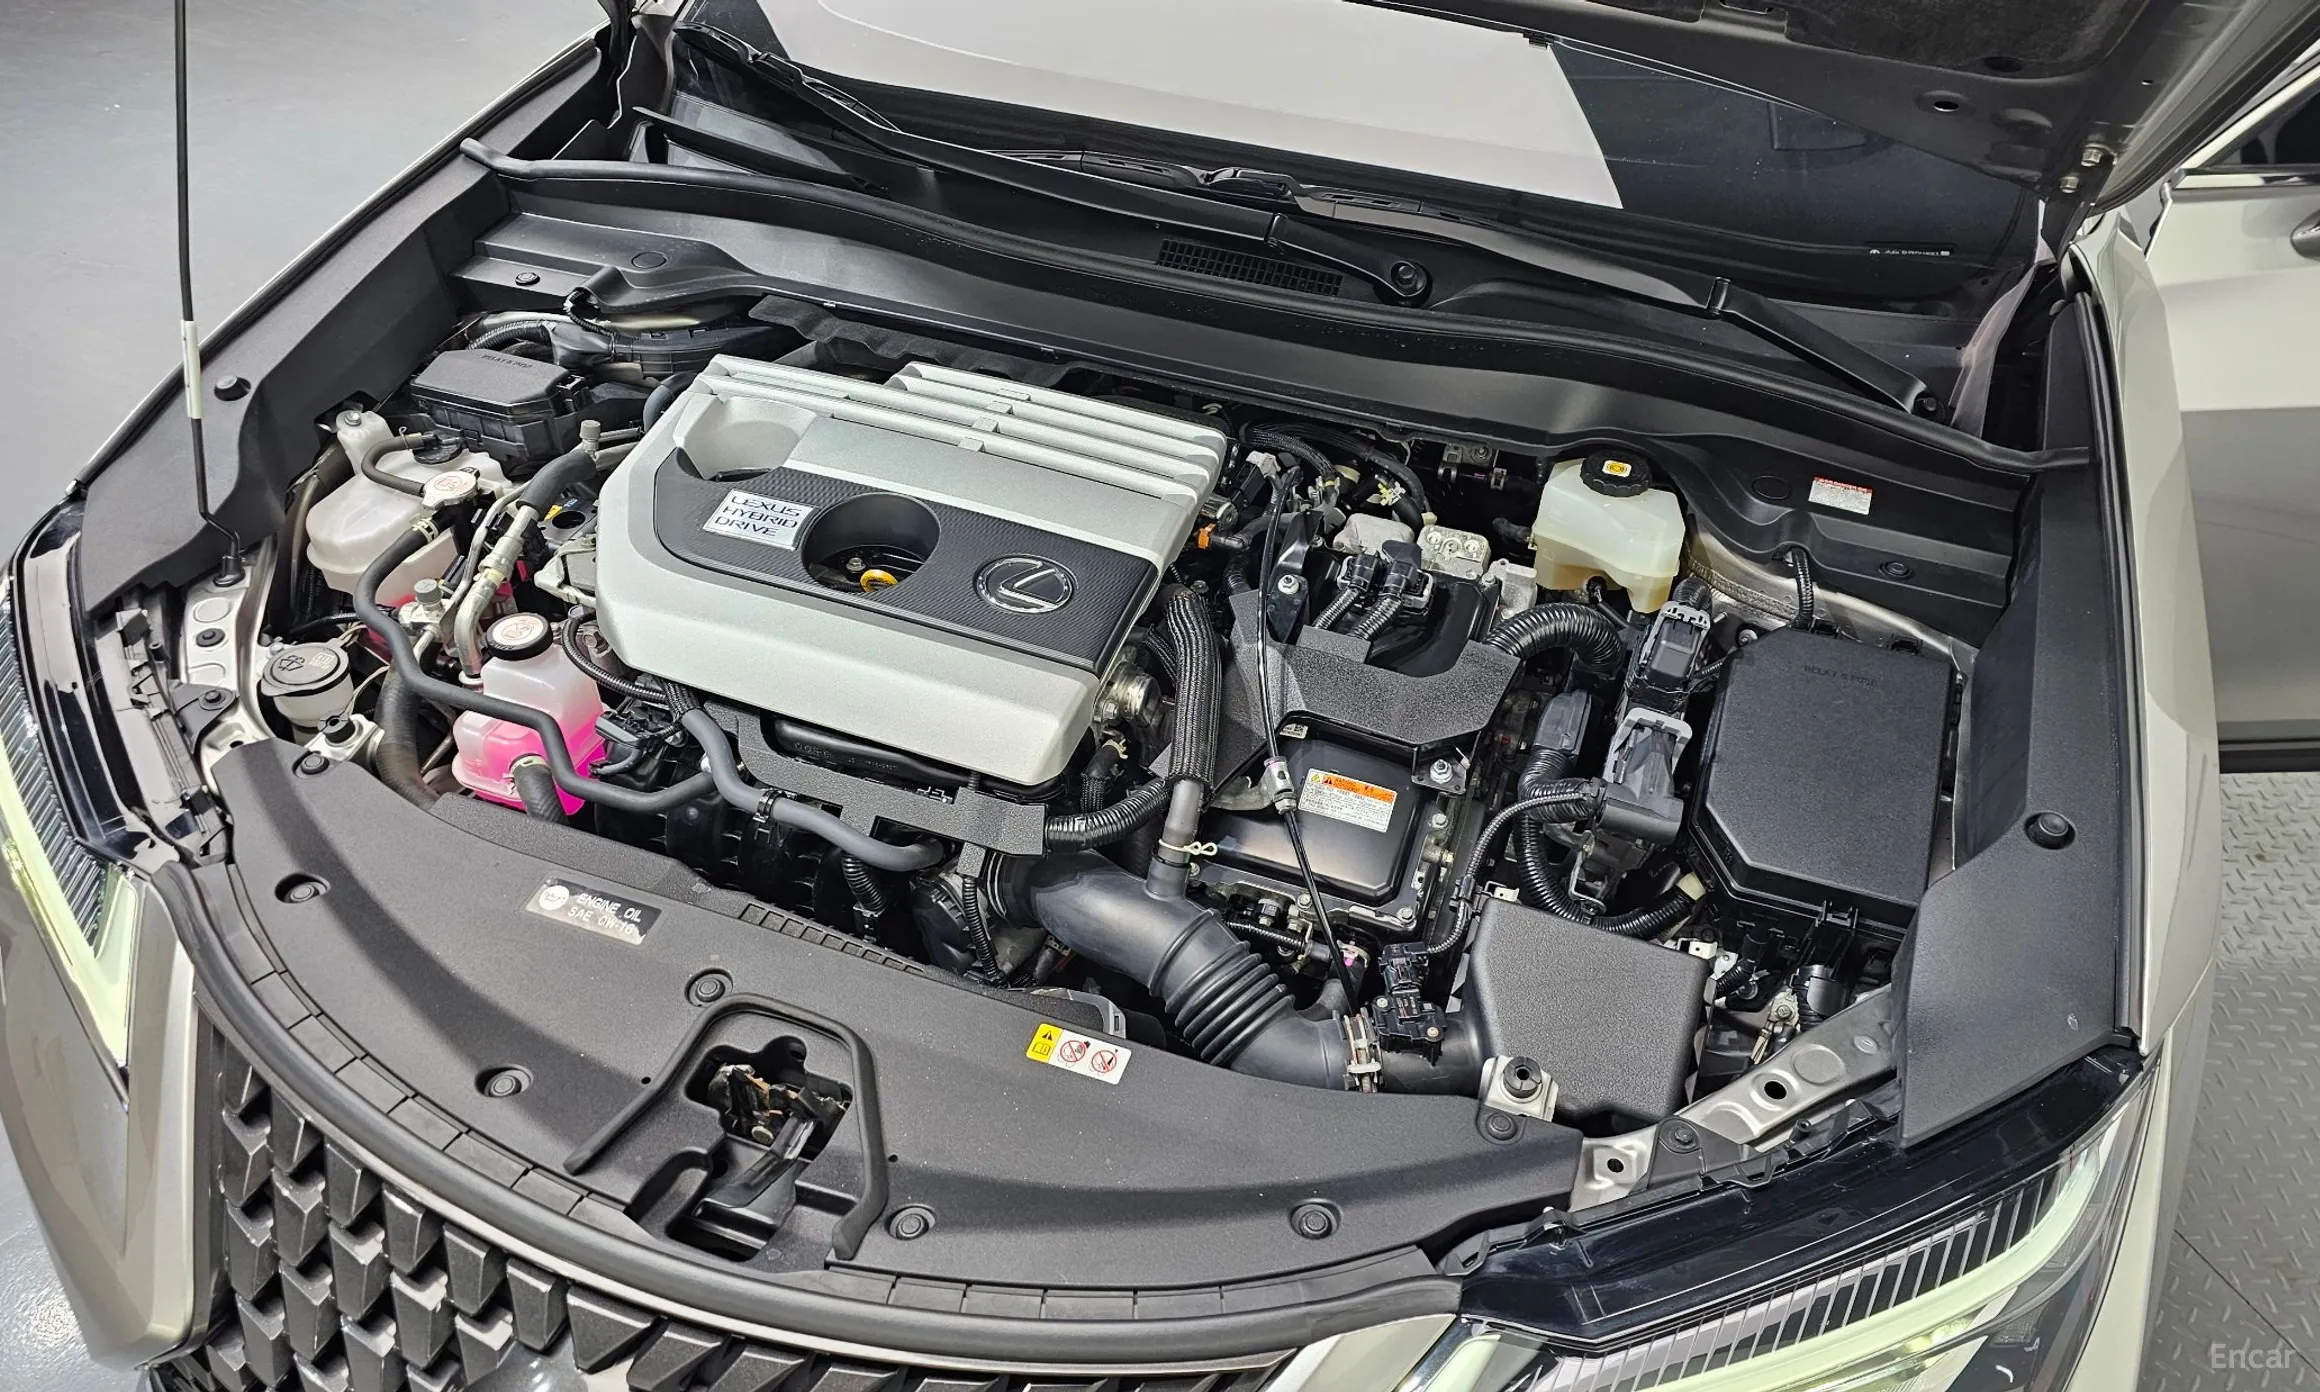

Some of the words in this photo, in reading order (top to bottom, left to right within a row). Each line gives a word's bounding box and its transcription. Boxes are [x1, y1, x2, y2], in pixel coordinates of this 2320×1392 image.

[722, 506, 798, 528] HYBRID
[731, 496, 802, 517] LEXUS
[715, 516, 779, 537] DRIVE
[568, 906, 594, 922] SAE
[576, 893, 621, 914] ENGINE
[623, 907, 642, 923] OIL
